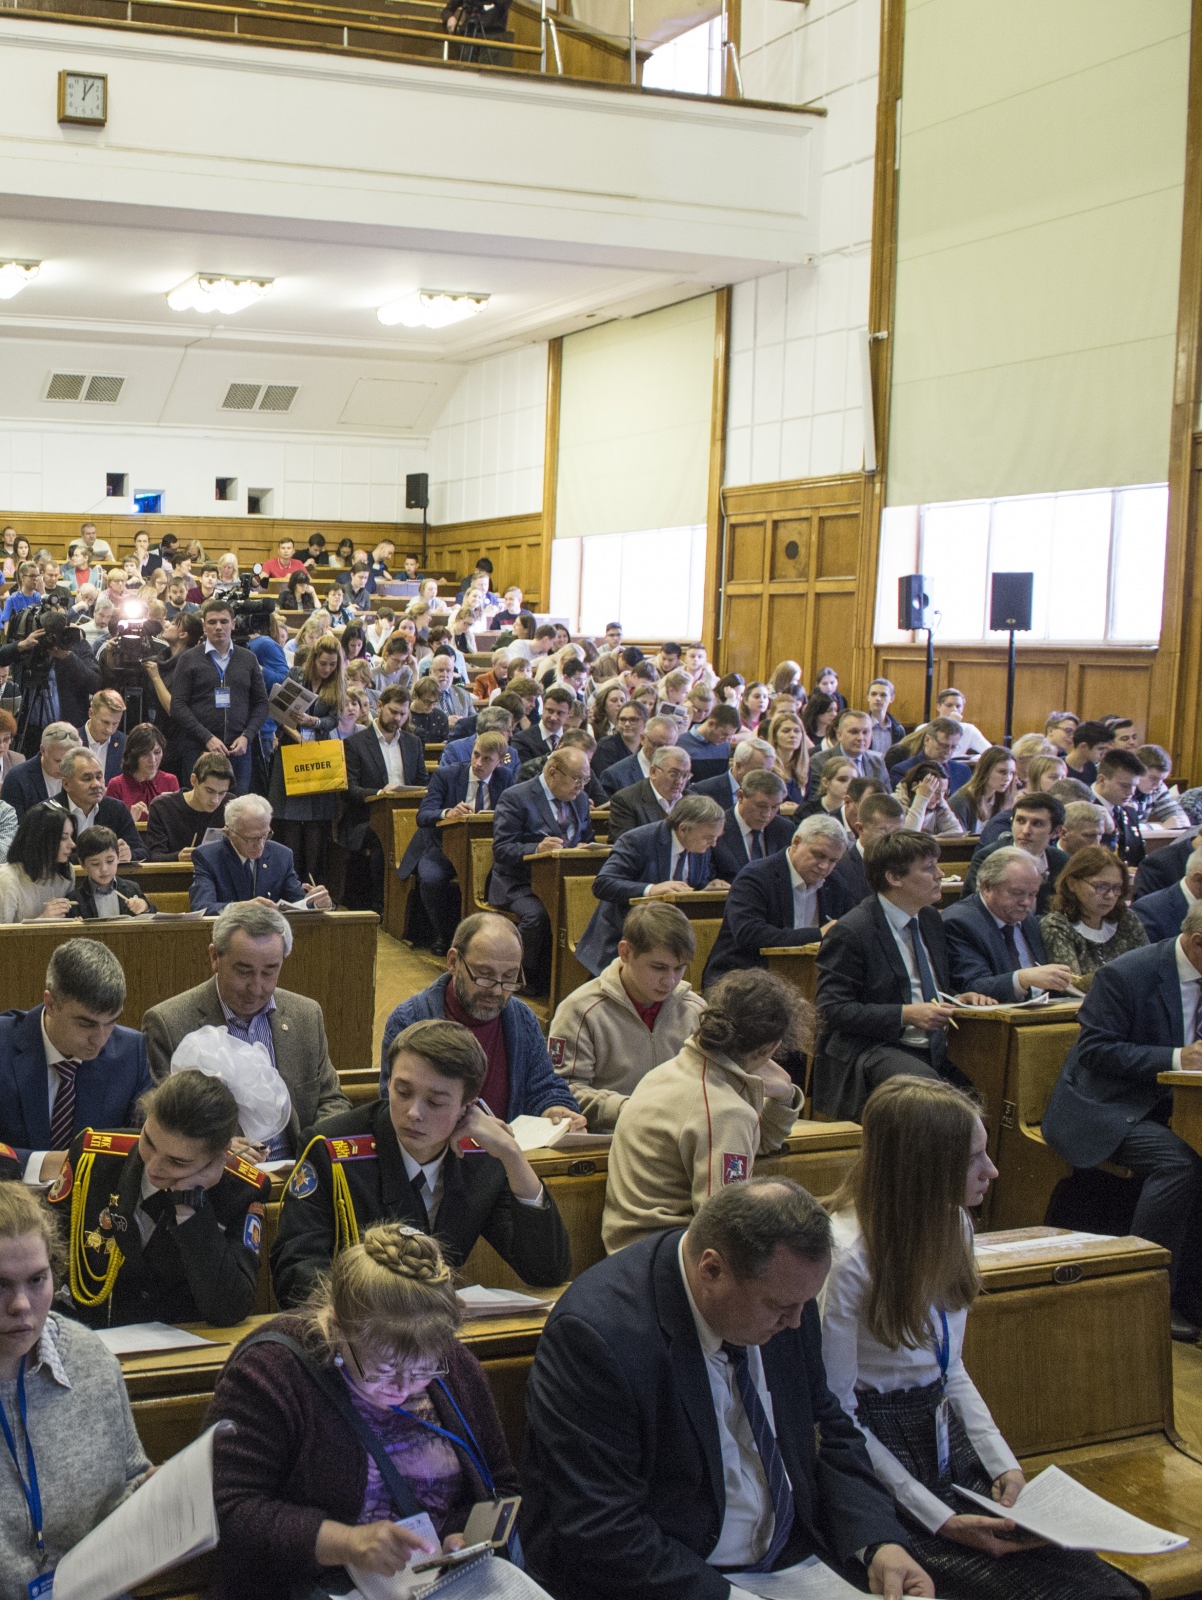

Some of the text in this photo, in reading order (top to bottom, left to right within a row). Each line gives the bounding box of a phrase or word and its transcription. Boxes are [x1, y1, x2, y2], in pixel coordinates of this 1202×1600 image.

[294, 761, 331, 773] GREYDER
[579, 1163, 588, 1173] 10
[1064, 1268, 1073, 1279] 11
